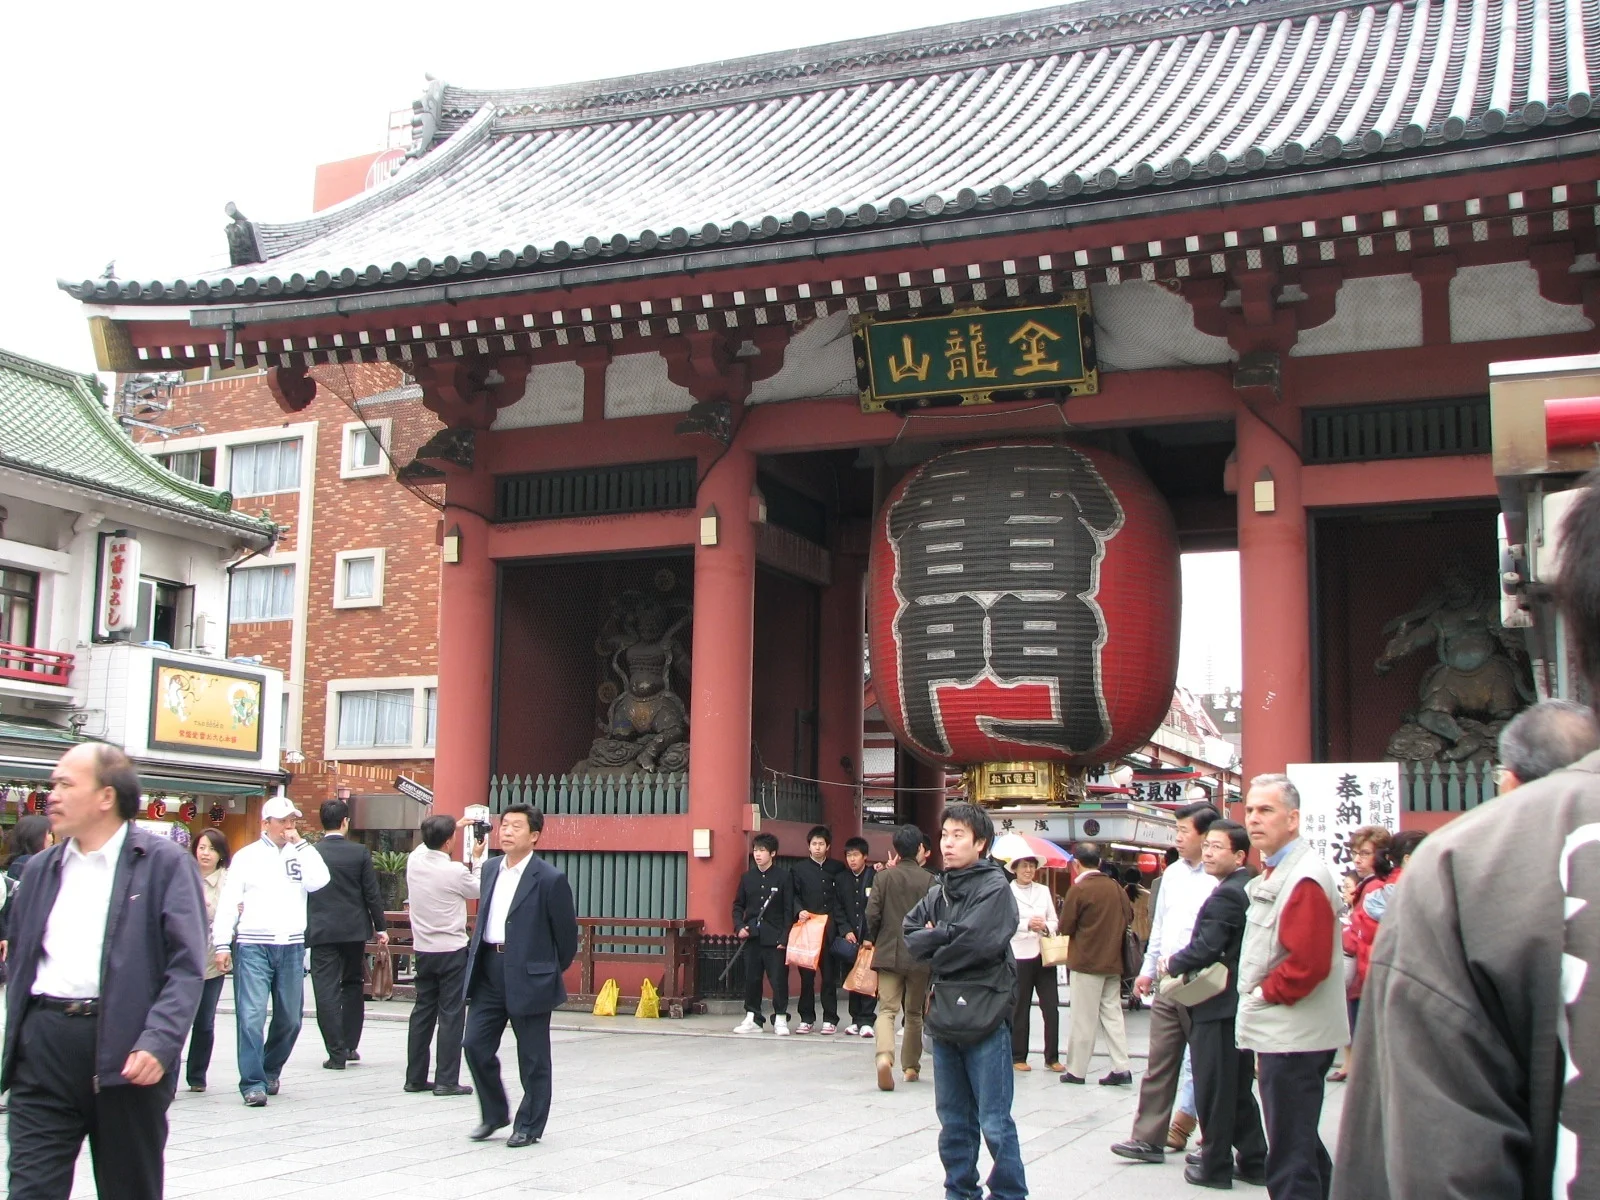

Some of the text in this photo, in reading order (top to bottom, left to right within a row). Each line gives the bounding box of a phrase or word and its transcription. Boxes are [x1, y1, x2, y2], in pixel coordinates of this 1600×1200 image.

[886, 444, 1126, 756] 雷門
[990, 772, 1035, 784] 松下電器
